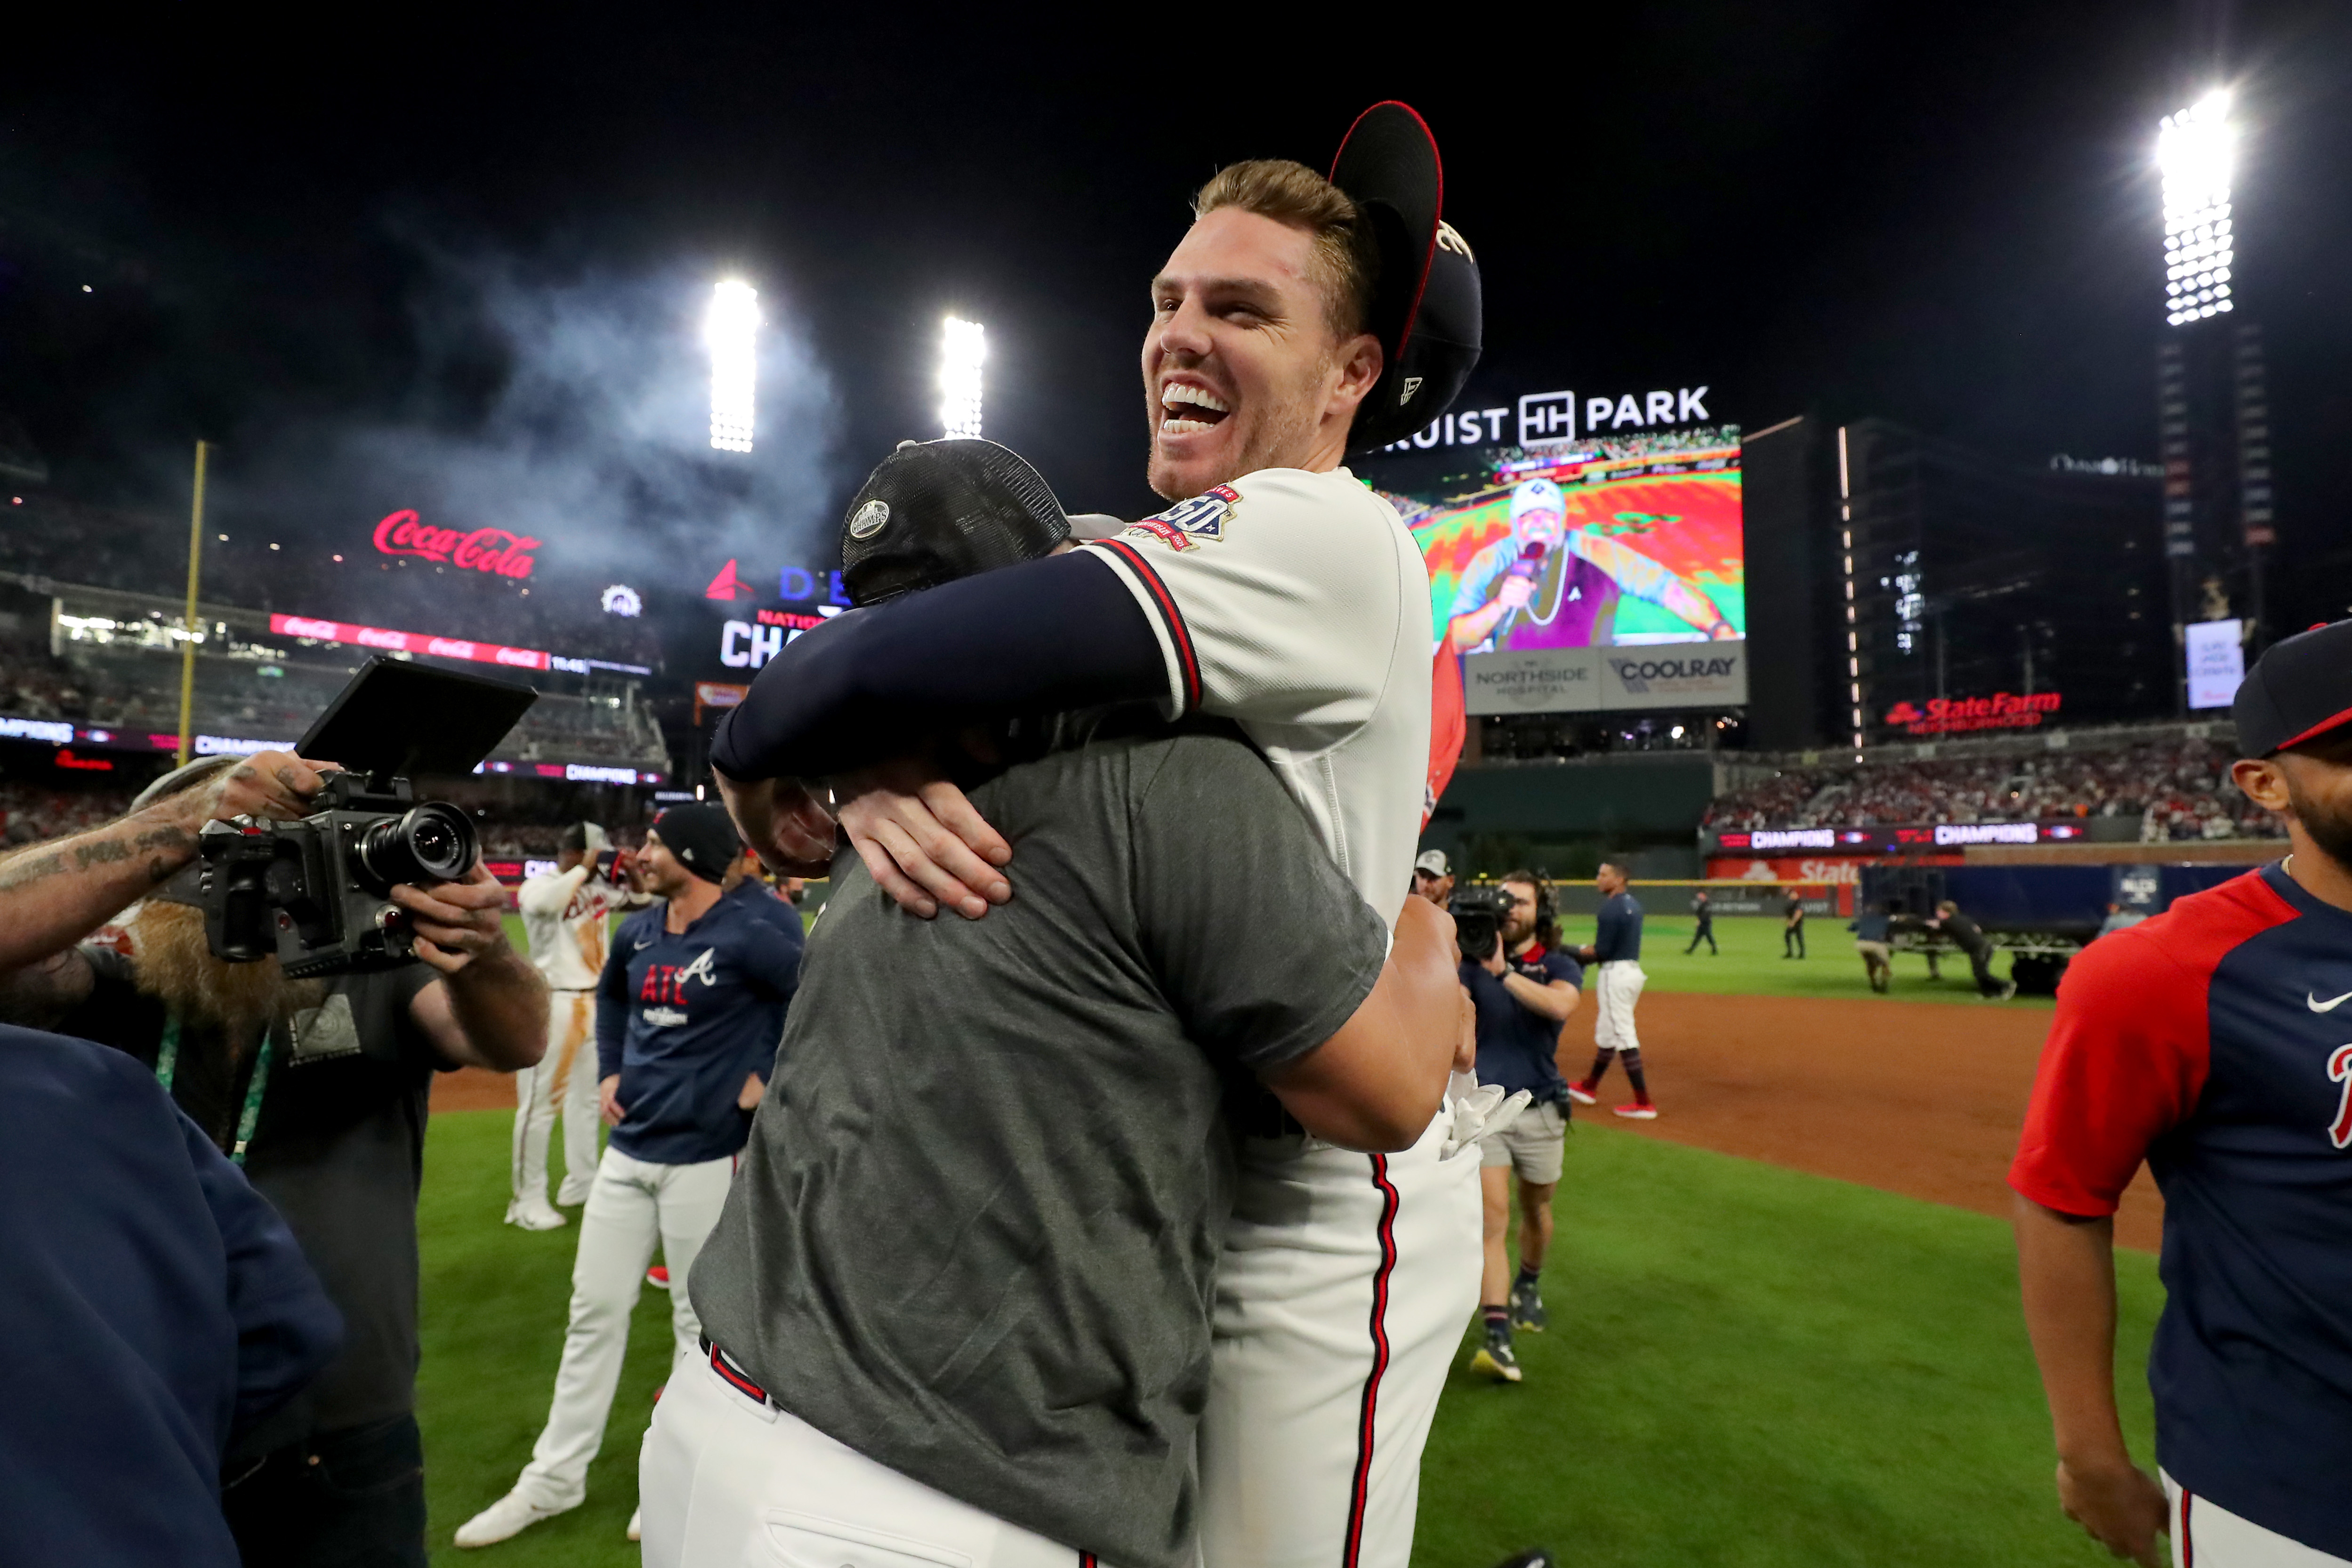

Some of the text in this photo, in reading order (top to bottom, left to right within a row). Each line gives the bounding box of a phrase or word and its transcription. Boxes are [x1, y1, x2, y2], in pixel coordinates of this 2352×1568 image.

[1366, 386, 1710, 452] UIST PARK
[851, 510, 887, 533] CHAMPS
[373, 508, 543, 579] Coca-Cola
[1172, 534, 1184, 547] 2021
[757, 609, 830, 631] NATIO
[720, 619, 806, 669] CH
[1475, 667, 1588, 685] NORTHSIDE
[1621, 657, 1737, 680] COOLRAY
[566, 763, 637, 785] CHAMPIONS
[1751, 828, 1835, 849] CHAMPIONS
[1934, 822, 2038, 845] CHAMPIONS
[640, 964, 688, 1005] ATL
